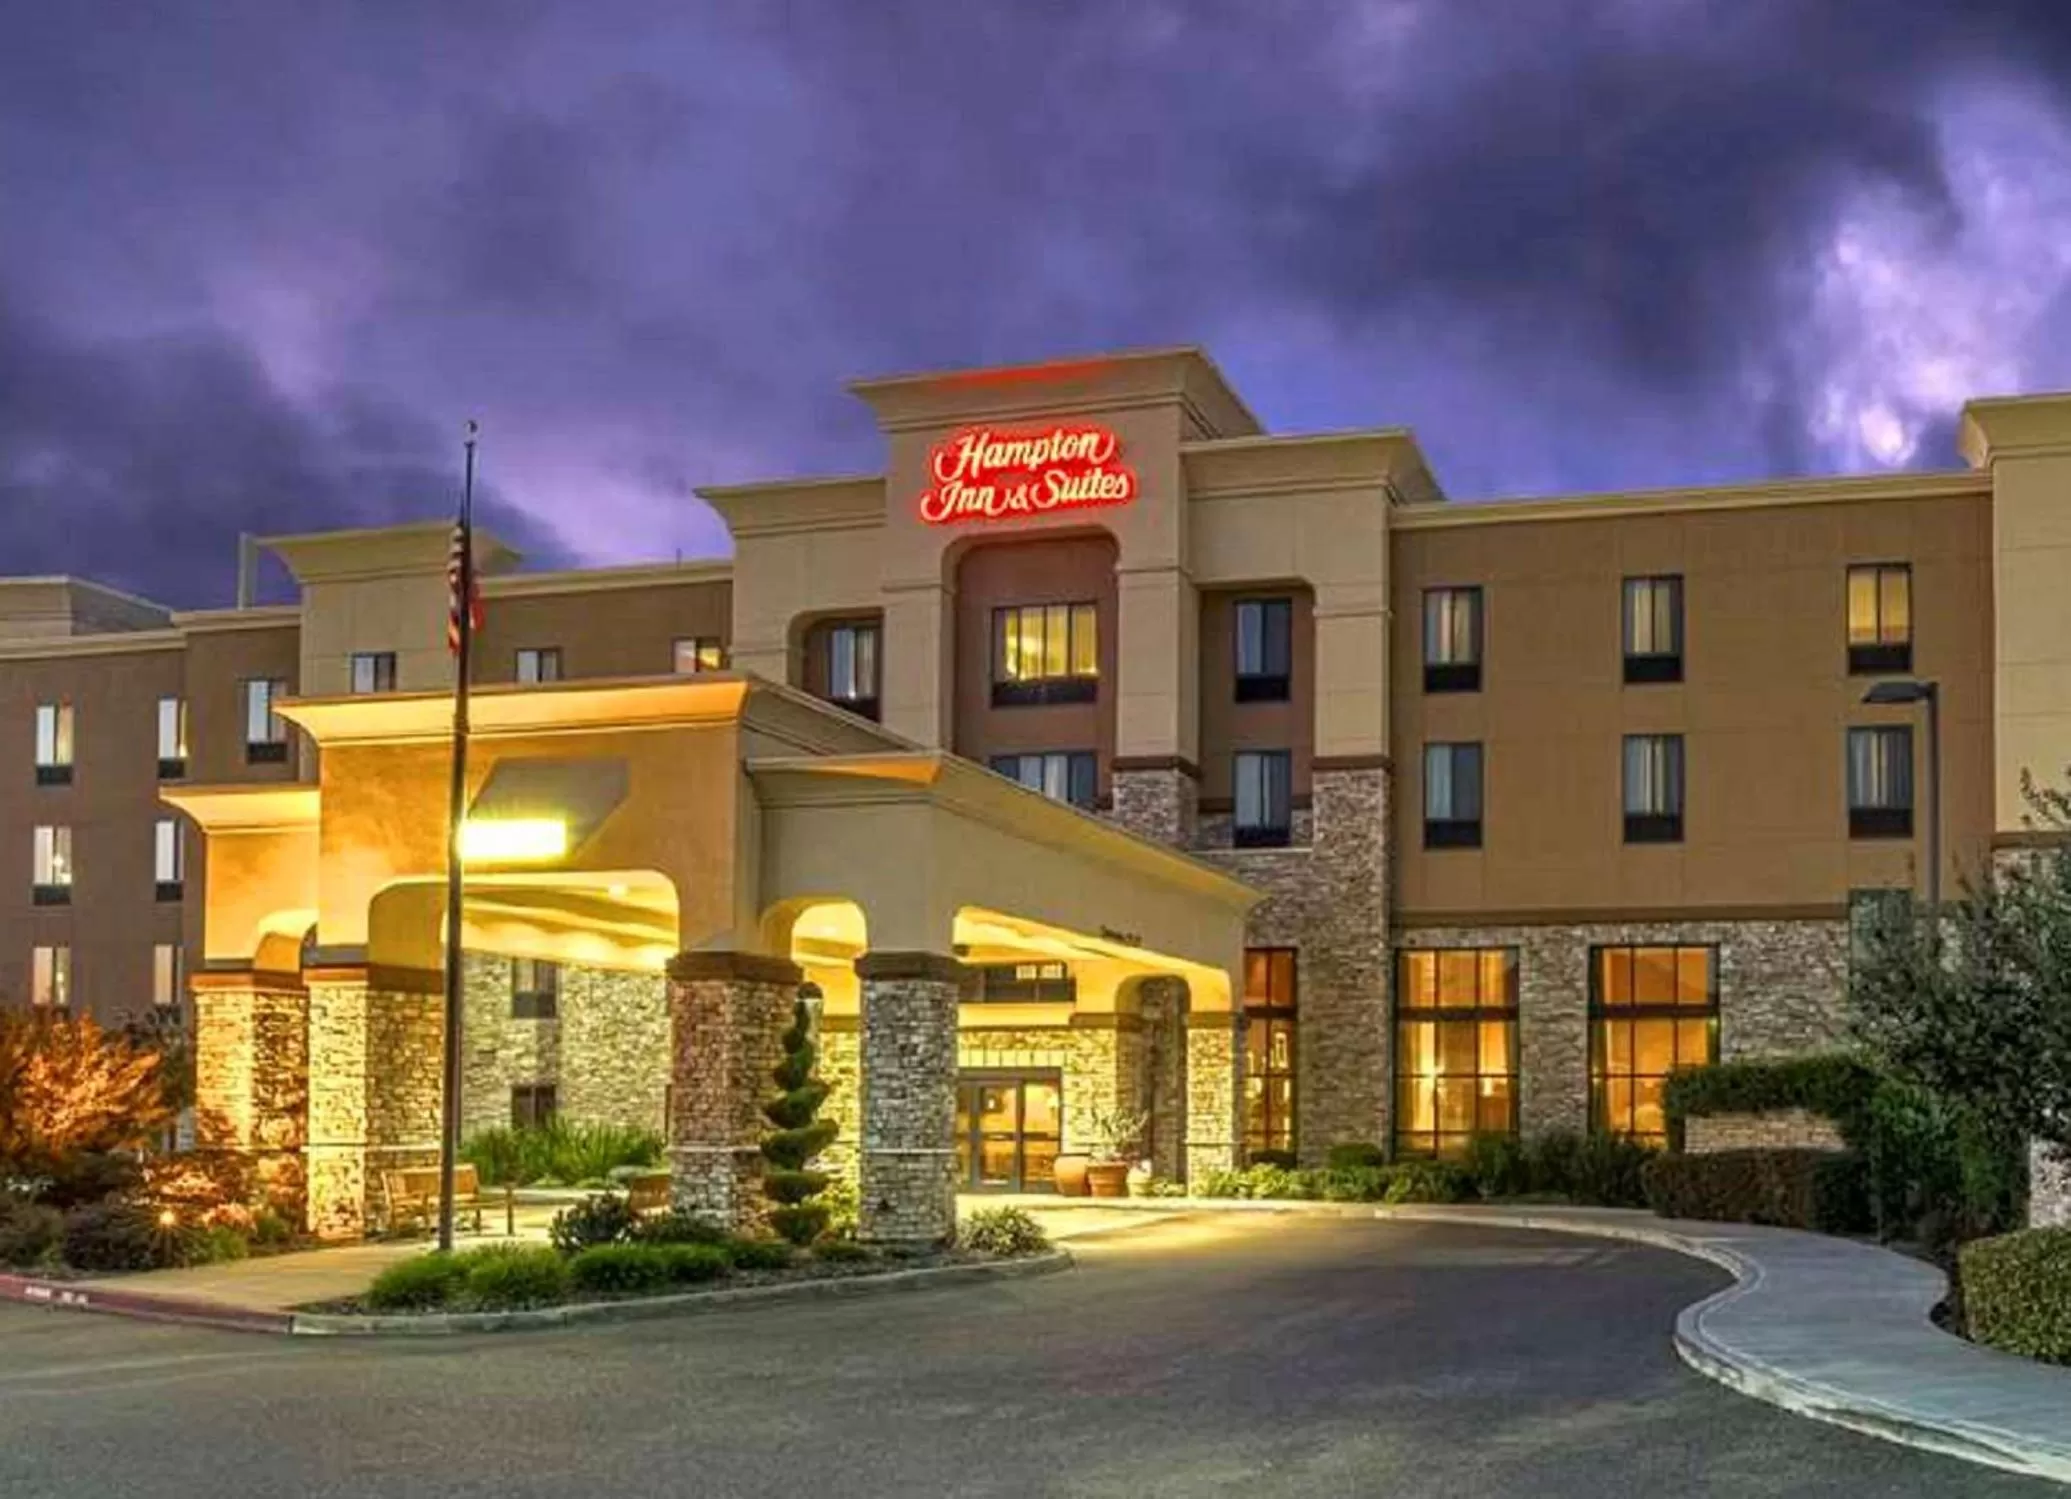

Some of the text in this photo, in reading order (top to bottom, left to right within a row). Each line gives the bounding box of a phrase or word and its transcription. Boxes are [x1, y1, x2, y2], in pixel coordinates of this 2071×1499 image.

[934, 429, 1115, 482] Hampton
[920, 467, 1129, 521] Inn & Suites
